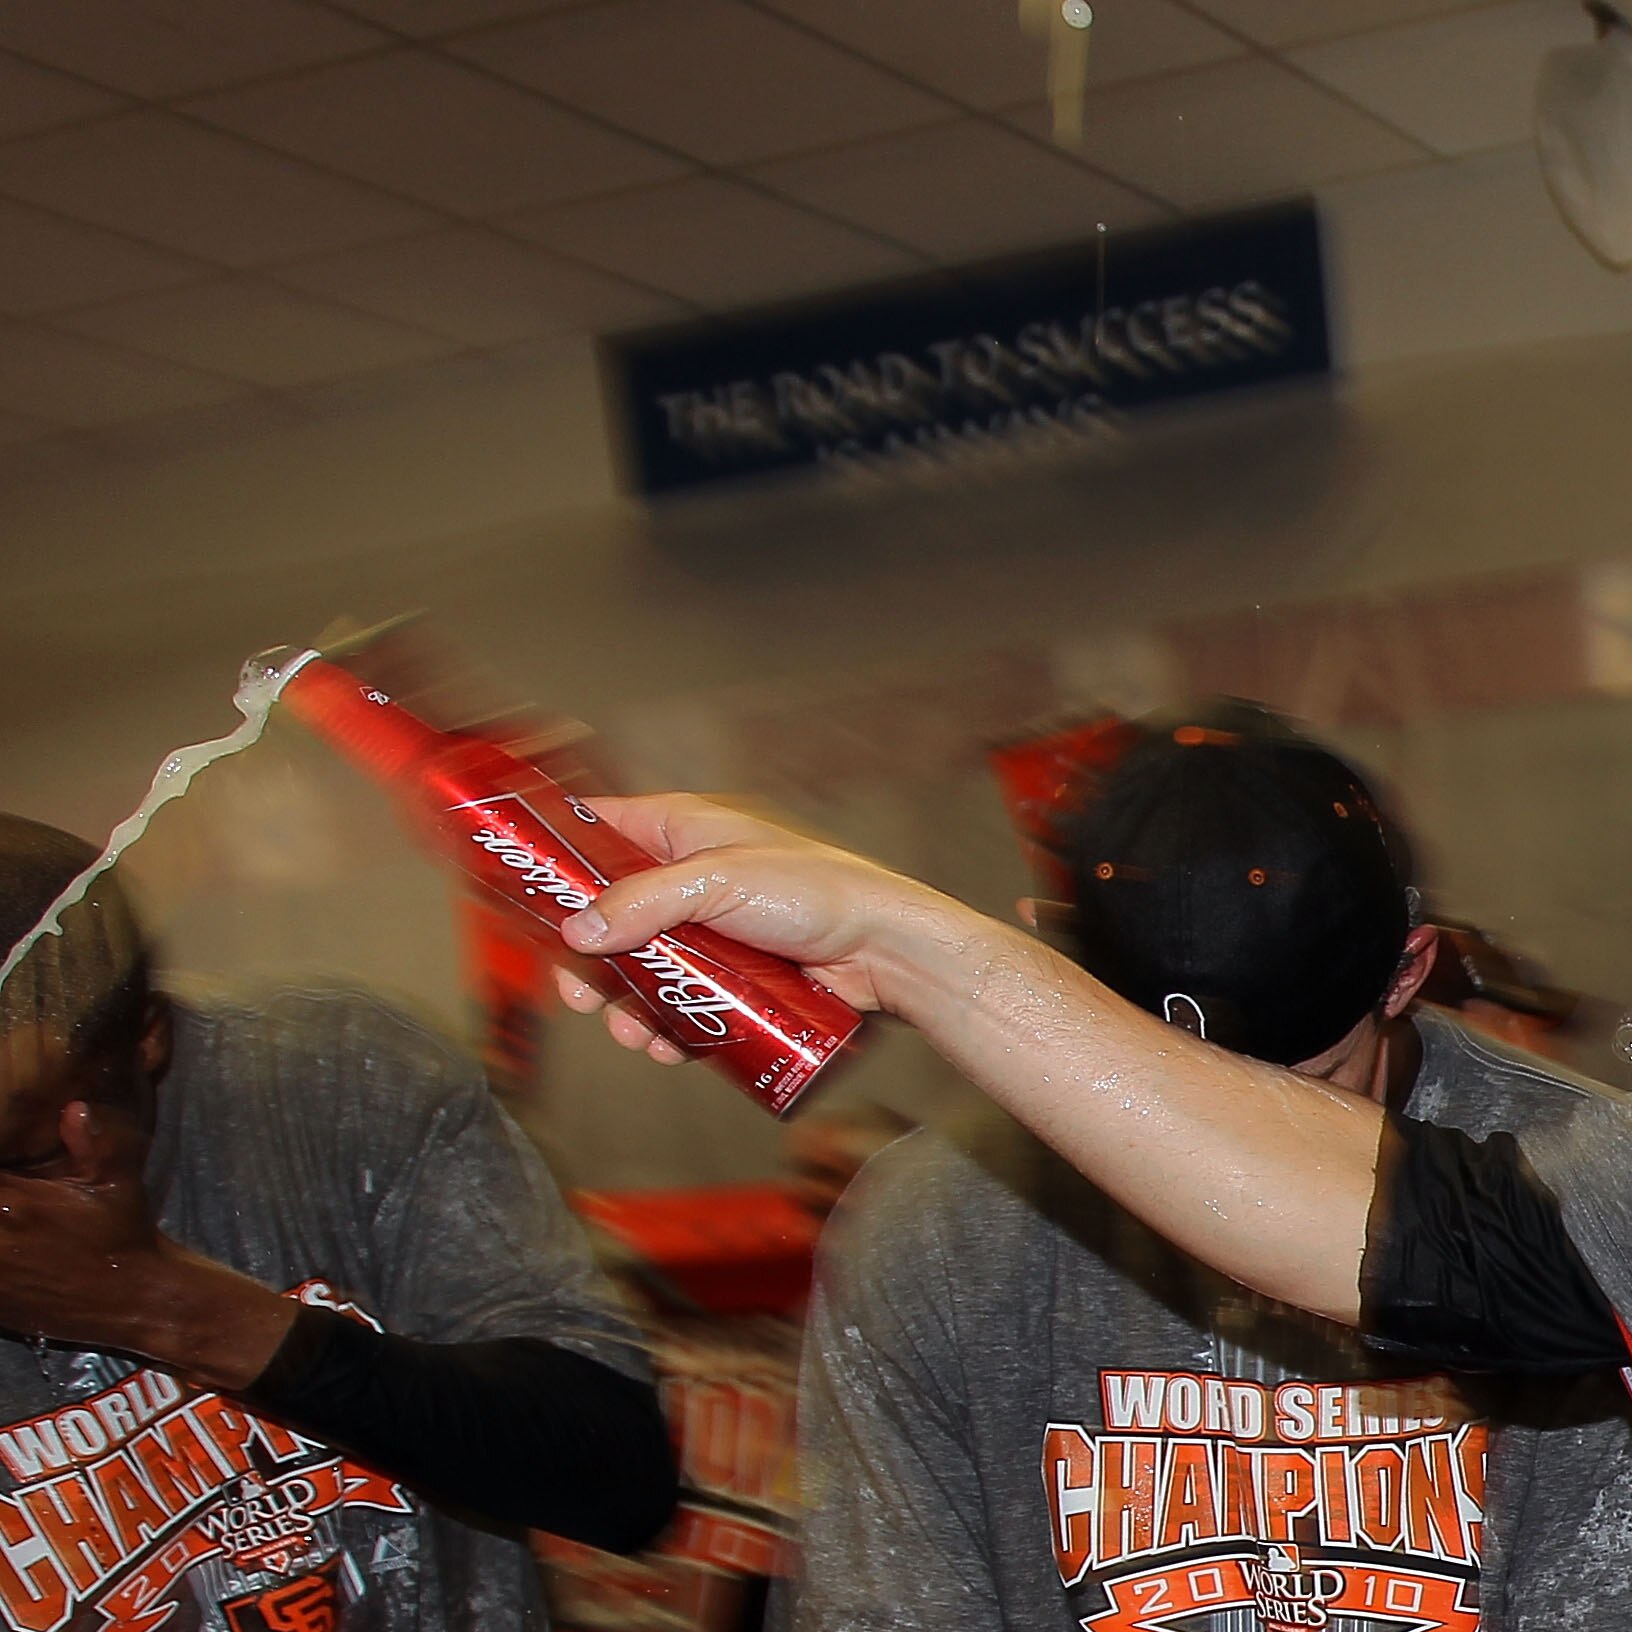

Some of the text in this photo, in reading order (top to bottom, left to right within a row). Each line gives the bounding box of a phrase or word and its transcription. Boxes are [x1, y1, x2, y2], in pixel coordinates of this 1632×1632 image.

[656, 280, 1280, 444] THE ROAD TO SUCCESS
[473, 828, 727, 1037] Bueiser
[755, 1072, 773, 1089] 16
[0, 1369, 183, 1482] WORLD
[200, 1480, 316, 1537] WORLD
[222, 1509, 314, 1558] SERIES
[121, 1543, 190, 1610] 20
[1133, 1568, 1225, 1615] 20
[1237, 1561, 1345, 1600] WORLD
[1364, 1575, 1424, 1613] 10
[1256, 1591, 1328, 1627] SERIES
